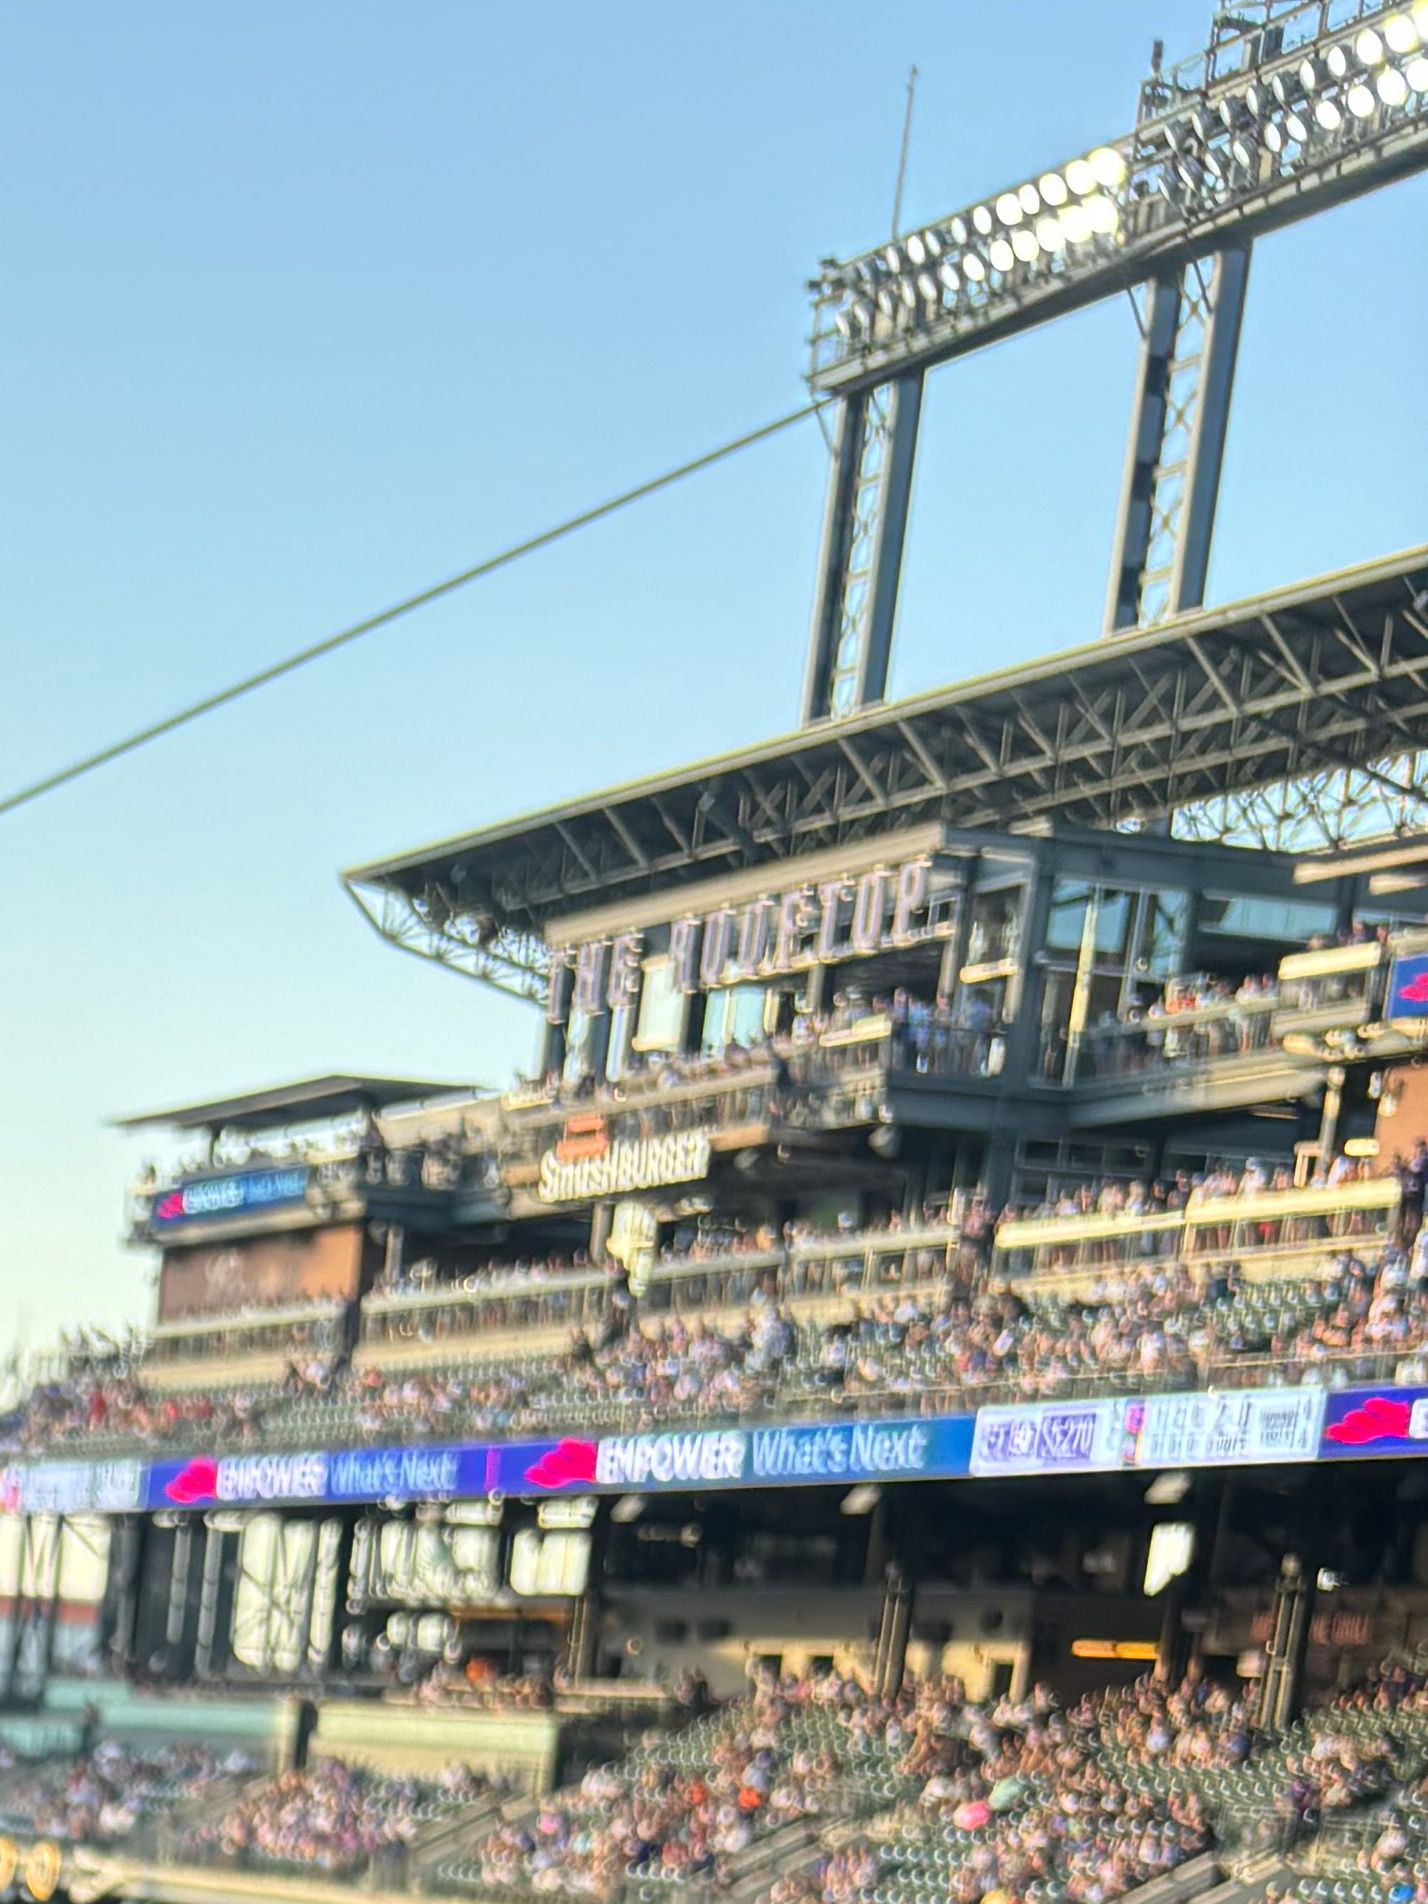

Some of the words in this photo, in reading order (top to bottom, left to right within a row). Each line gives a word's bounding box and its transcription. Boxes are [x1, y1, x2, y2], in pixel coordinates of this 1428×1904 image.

[547, 928, 643, 1024] THE
[597, 1431, 745, 1484] EMPOWER
[751, 1426, 849, 1478] What's
[850, 1422, 927, 1472] Next
